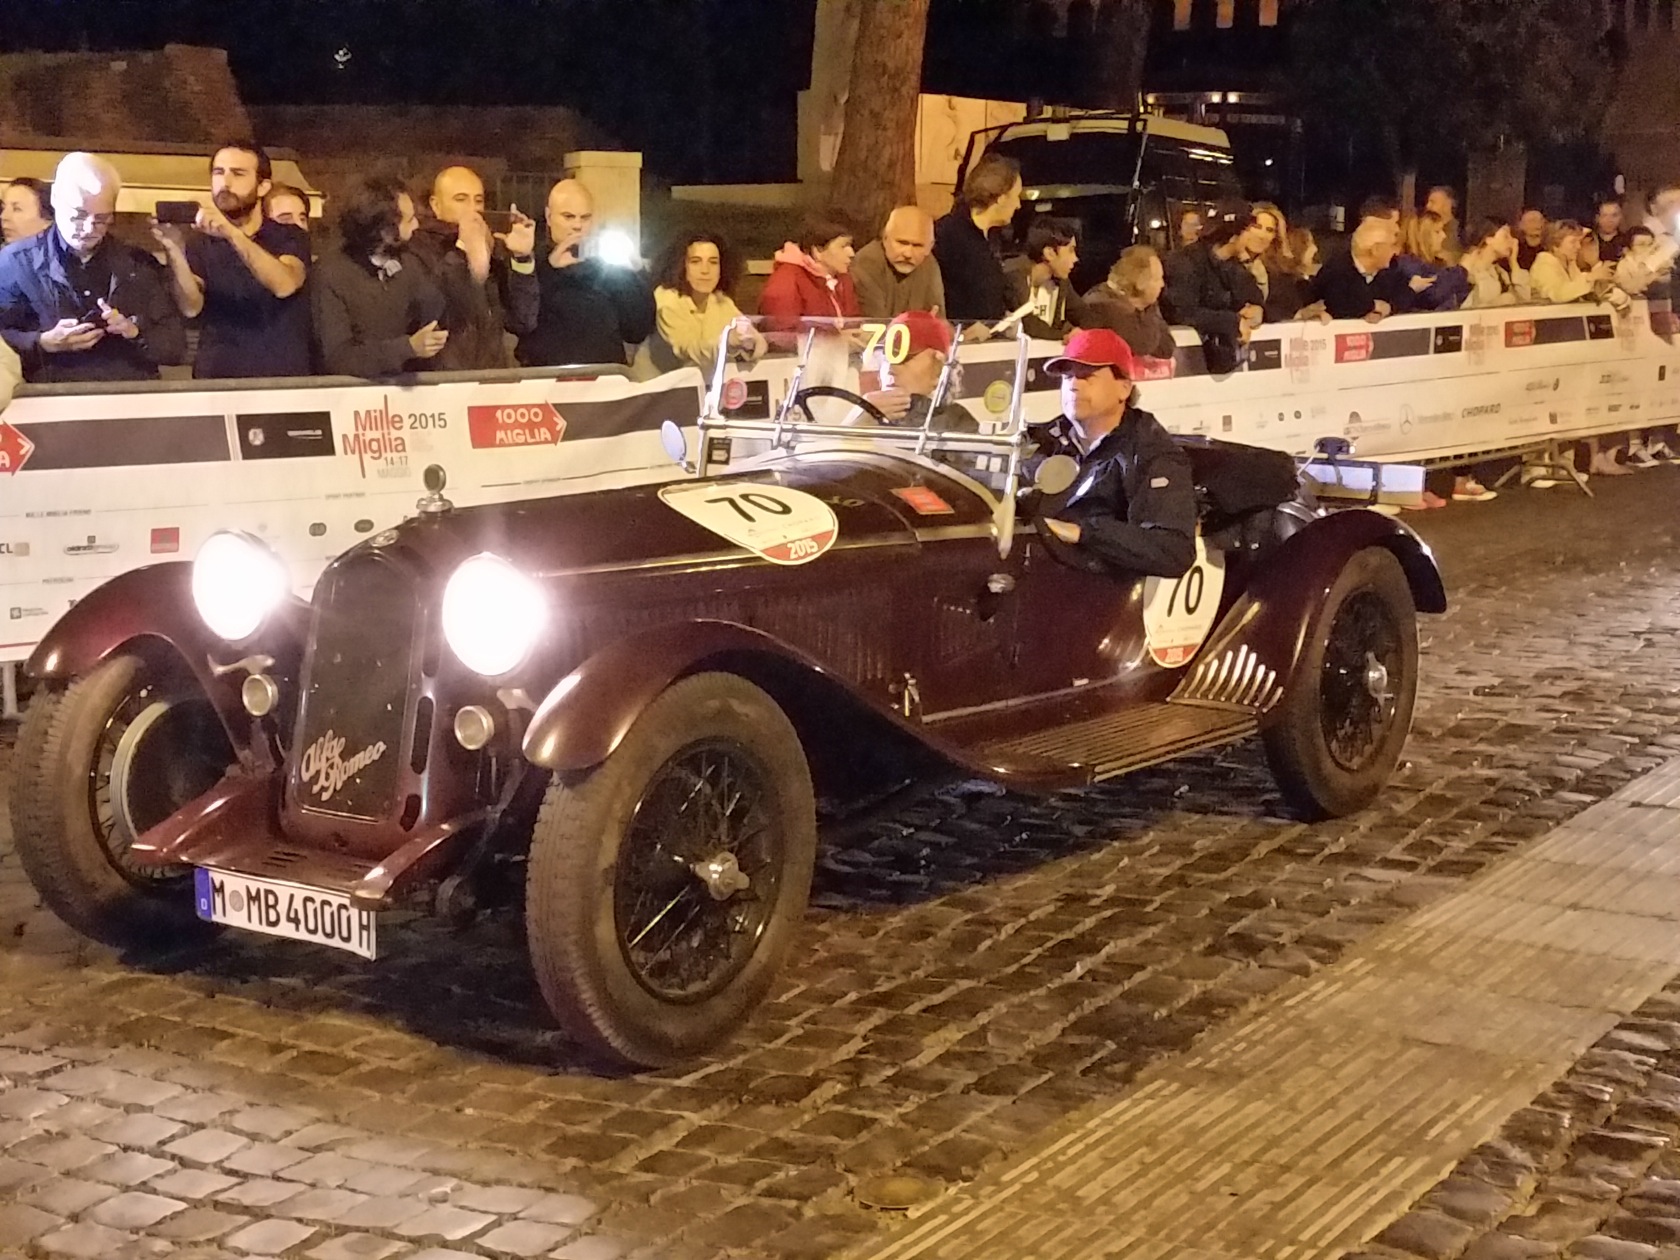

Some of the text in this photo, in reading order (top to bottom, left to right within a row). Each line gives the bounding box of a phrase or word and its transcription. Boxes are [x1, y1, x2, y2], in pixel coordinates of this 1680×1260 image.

[862, 323, 911, 365] 70
[354, 394, 447, 432] Mille 2015
[495, 408, 543, 424] 1000
[1462, 403, 1501, 418] CHOPARD
[495, 427, 552, 445] MIGLIA
[341, 432, 407, 479] Miglia
[704, 493, 793, 523] 70
[786, 538, 819, 559] 2015
[301, 729, 346, 794] Alfa
[320, 741, 387, 801] Romeo
